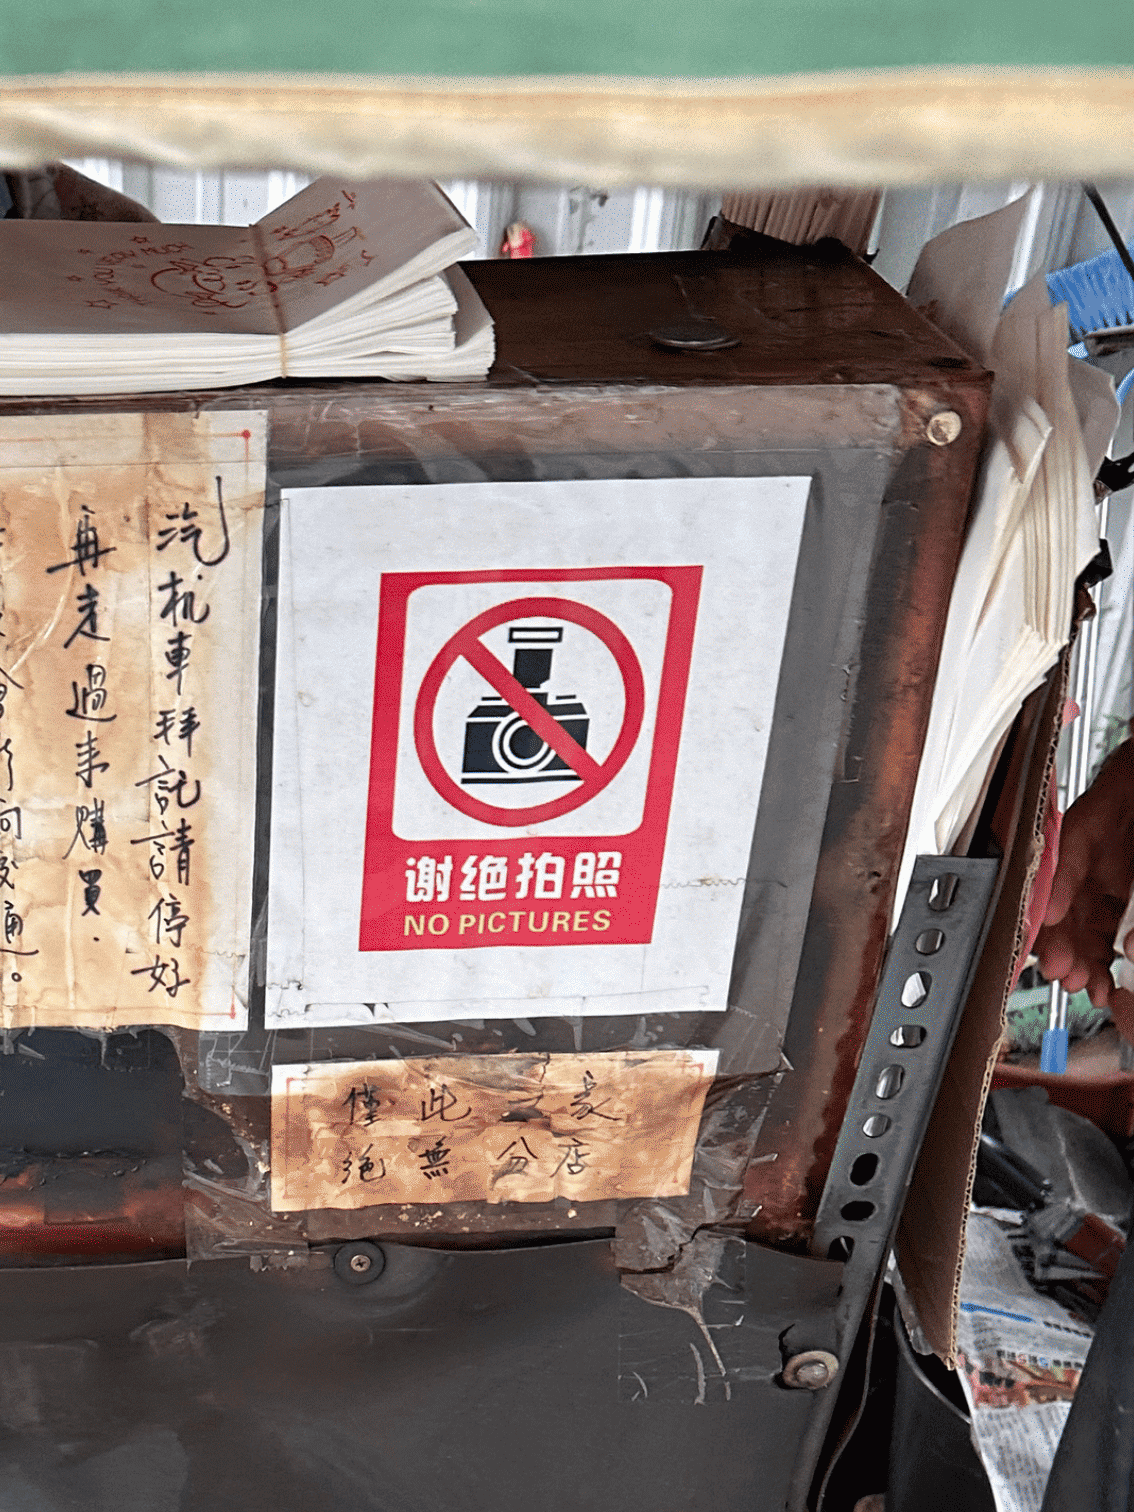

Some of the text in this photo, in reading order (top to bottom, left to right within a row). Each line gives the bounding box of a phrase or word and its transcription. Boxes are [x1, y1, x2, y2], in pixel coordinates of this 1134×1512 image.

[404, 851, 623, 903] 谢绝拍照
[403, 908, 613, 937] NO PICTURES
